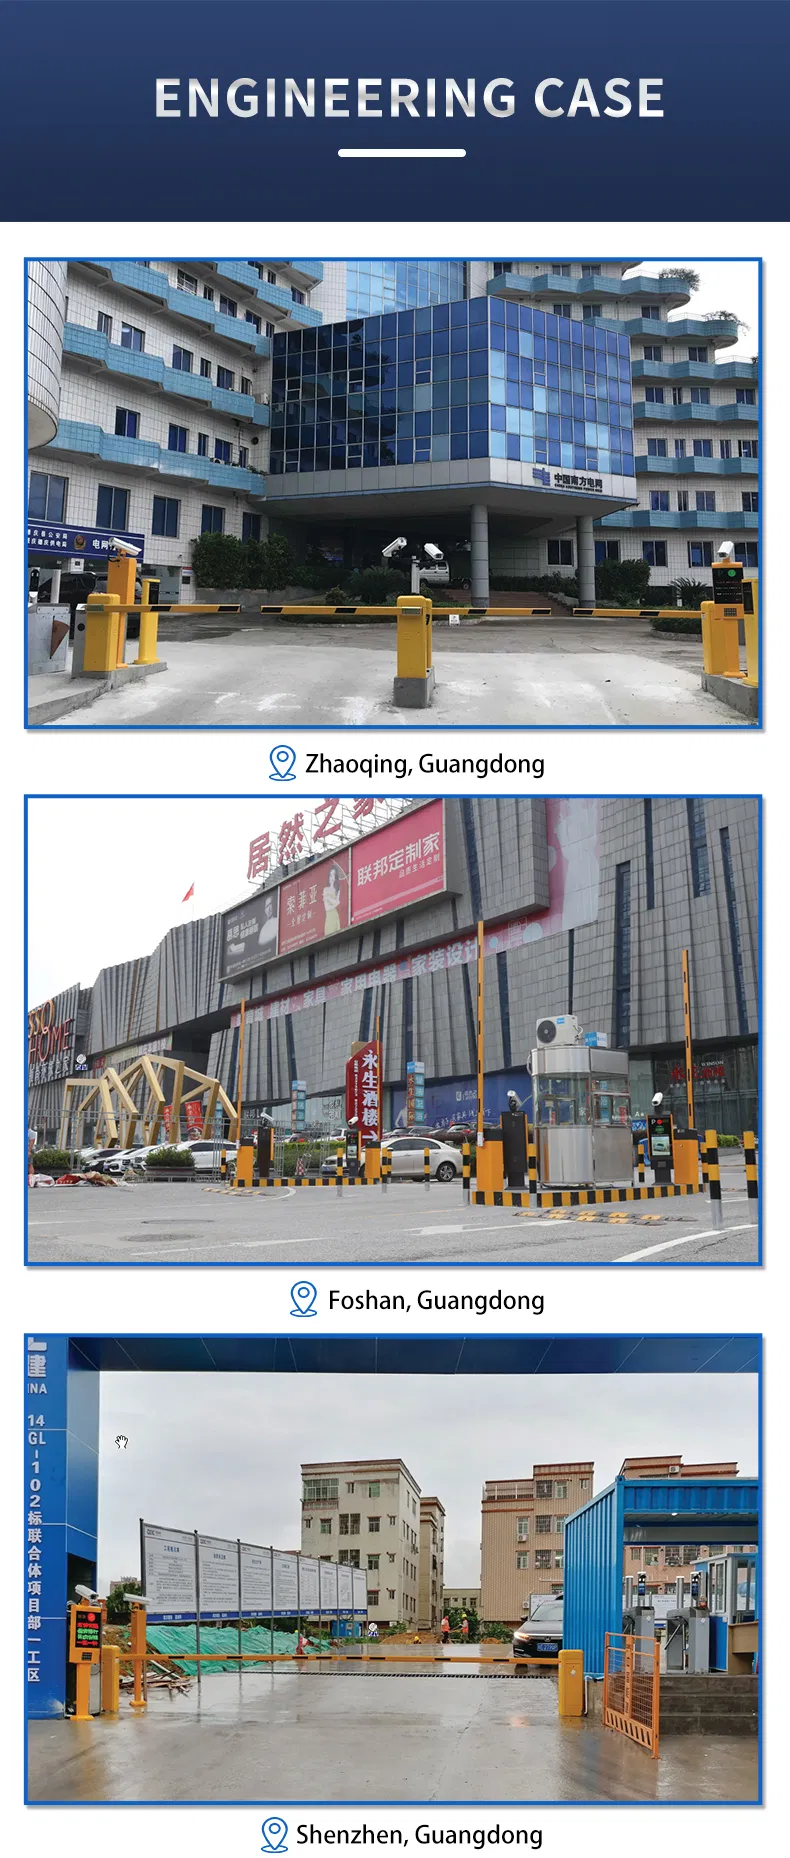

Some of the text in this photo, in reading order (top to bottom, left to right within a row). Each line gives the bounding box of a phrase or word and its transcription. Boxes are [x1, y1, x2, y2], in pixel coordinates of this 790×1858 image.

[554, 473, 603, 489] 中国南方电网
[357, 832, 440, 887] 联邦定制家
[340, 963, 397, 997] 家用电器
[411, 936, 479, 978] 家装设计
[29, 1017, 74, 1065] HOME
[361, 1049, 378, 1127] 永生酒楼
